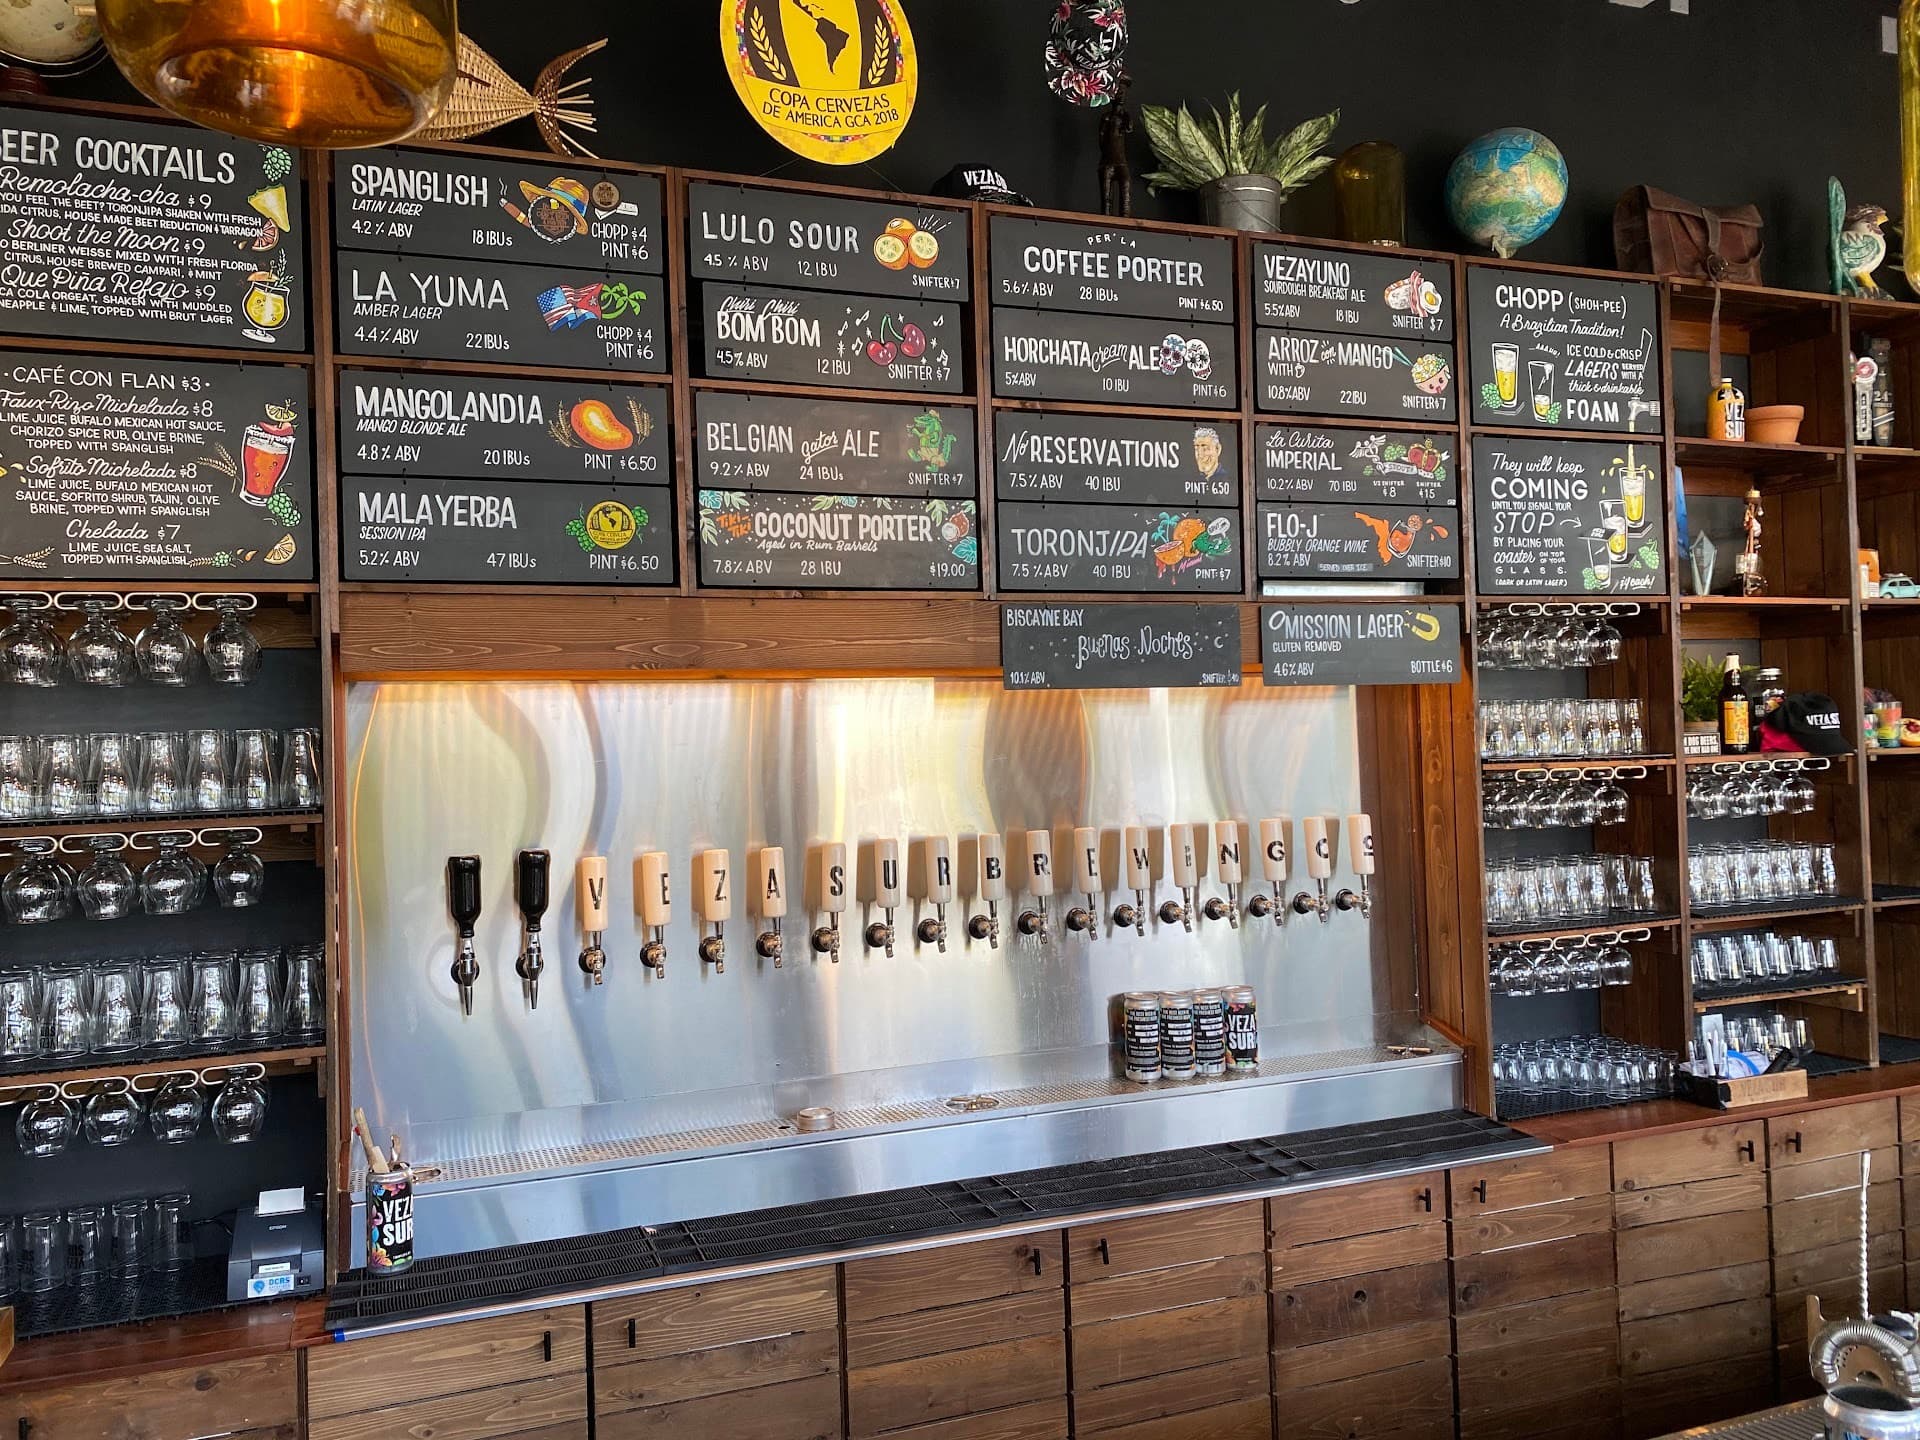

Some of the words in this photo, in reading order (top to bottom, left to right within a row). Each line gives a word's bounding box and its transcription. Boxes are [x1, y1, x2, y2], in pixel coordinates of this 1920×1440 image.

[769, 88, 810, 110] COPA
[816, 94, 890, 113] CERVEZAS
[763, 101, 780, 118] DE
[786, 110, 841, 128] AMERICA
[845, 115, 871, 128] GCA
[875, 108, 899, 125] 2018
[0, 129, 59, 166] EER
[75, 137, 235, 184] COCKTAILS
[0, 165, 180, 206] Remolacha-cha
[351, 164, 488, 208] SPANGLISH
[1, 192, 22, 203] YOU
[26, 194, 49, 206] FEEL
[51, 197, 72, 207] THE
[75, 199, 104, 212] BEET?
[106, 202, 163, 216] TORONJIPA
[165, 208, 201, 221] SHAKEN
[203, 212, 229, 223] WITH
[232, 214, 261, 226] FRESH
[352, 199, 387, 213] LATIN
[387, 201, 423, 216] LAGER
[8, 218, 73, 242] Shoot
[76, 224, 112, 244] the
[114, 226, 180, 253] Moon
[387, 222, 413, 238] ABV
[486, 230, 513, 247] IBUs
[591, 222, 629, 240] CHOPP
[631, 226, 648, 242] $4
[702, 211, 775, 245] LULO
[788, 220, 860, 254] SOUR
[601, 242, 629, 259] PINT
[631, 245, 649, 260] $6
[1023, 246, 1110, 279] COFFEE
[1117, 254, 1205, 287] PORTER
[1263, 254, 1350, 288] VEZAYUNO
[1, 264, 48, 287] Que
[52, 267, 106, 292] Piña
[110, 272, 190, 301] Refajo
[352, 269, 397, 302] LA
[409, 272, 509, 311] YUMA
[1080, 286, 1092, 301] 28
[1096, 287, 1119, 302] IBUs
[1263, 280, 1307, 297] SOURDOUGH
[1308, 287, 1349, 301] BREAKFAST
[1350, 288, 1366, 303] ALE
[353, 302, 400, 318] AMBER
[402, 305, 443, 320] LAGER
[1495, 284, 1564, 312] CHOPP
[1568, 291, 1627, 320] (SHOH-PEE)
[596, 324, 633, 341] CHOPP
[637, 329, 652, 343] $4
[716, 310, 766, 343] BOM
[771, 314, 821, 348] BOM
[1392, 315, 1424, 330] SNIFTER
[1499, 313, 1511, 329] A
[1512, 314, 1568, 338] Brazilian
[1569, 319, 1625, 339] Tradition!
[606, 342, 633, 359] PINT
[637, 345, 654, 360] $6
[1004, 336, 1092, 368] HORCHATA
[1128, 345, 1160, 371] ALE
[1268, 336, 1320, 364] ARROZ
[1321, 346, 1337, 361] con
[1337, 342, 1393, 369] MANGO
[13, 365, 65, 384] CAFÉ
[70, 370, 112, 387] CON
[121, 372, 175, 389] FLAN
[887, 364, 932, 381] SNIFTER
[936, 366, 951, 382] $7
[1564, 360, 1620, 381] LAGERS
[0, 390, 94, 415] Faux-Rizo
[95, 393, 189, 416] Michelada
[193, 400, 213, 417] $8
[355, 385, 544, 425] MANGOLANDIA
[1566, 398, 1620, 422] FOAM
[356, 419, 397, 433] MANGO
[400, 420, 446, 436] BLONDE
[446, 423, 468, 437] ALE
[1266, 430, 1286, 449] La
[1288, 431, 1335, 449] Curita
[25, 439, 73, 450] TOPPED
[76, 442, 108, 451] WITH
[111, 442, 174, 454] SPANGLISH
[706, 422, 793, 454] BELGIAN
[841, 428, 881, 458] ALE
[1001, 430, 1029, 463] No
[1030, 435, 1180, 468] RESERVATIONS
[26, 455, 87, 477] Sofrito
[88, 457, 177, 479] Michelada
[180, 463, 197, 479] $8
[584, 453, 613, 470] PINT
[620, 456, 657, 471] $6.50
[1266, 450, 1343, 472] IMPERIAL
[1491, 452, 1522, 477] They
[1526, 455, 1552, 472] will
[1556, 457, 1585, 478] keep
[799, 466, 814, 481] 24
[817, 466, 844, 482] IBUs
[1085, 475, 1100, 490] 40
[1102, 476, 1121, 491] IBU
[1329, 480, 1340, 492] 70
[1342, 480, 1357, 492] IBU
[1490, 476, 1589, 500] COMING
[358, 492, 517, 529] MALAYERBA
[66, 518, 149, 540] Chelada
[157, 524, 181, 540] $7
[359, 526, 407, 541] SESSION
[407, 527, 426, 541] IPA
[754, 511, 852, 541] COCONUT
[858, 513, 933, 542] PORTER
[1267, 512, 1318, 538] FLO-J
[1494, 511, 1555, 534] STOP
[756, 537, 786, 554] Aged
[790, 540, 803, 550] in
[806, 540, 835, 552] Rum
[836, 540, 879, 553] Barrels
[1011, 528, 1149, 559] TORONJIPA
[1267, 538, 1302, 552] BUBBLY
[1305, 539, 1341, 553] ORANGE
[1344, 539, 1369, 553] WINE
[589, 554, 618, 569] PINT
[621, 555, 659, 571] $6.50
[800, 560, 817, 576] 28
[820, 560, 842, 576] IBU
[929, 562, 966, 578] $19.00
[1092, 565, 1107, 578] 40
[1112, 565, 1131, 579] IBU
[1006, 608, 1061, 627] BISCAYNE
[1063, 608, 1084, 627] BAY
[1268, 610, 1350, 640] OMISSION
[1357, 613, 1404, 639] LAGER
[1075, 633, 1131, 670] Buenas
[1138, 625, 1193, 660] Noches
[1272, 641, 1301, 653] GLUTEN
[1304, 641, 1342, 652] REMOVED
[1228, 1014, 1256, 1032] VEZA
[1228, 1032, 1257, 1050] SUR
